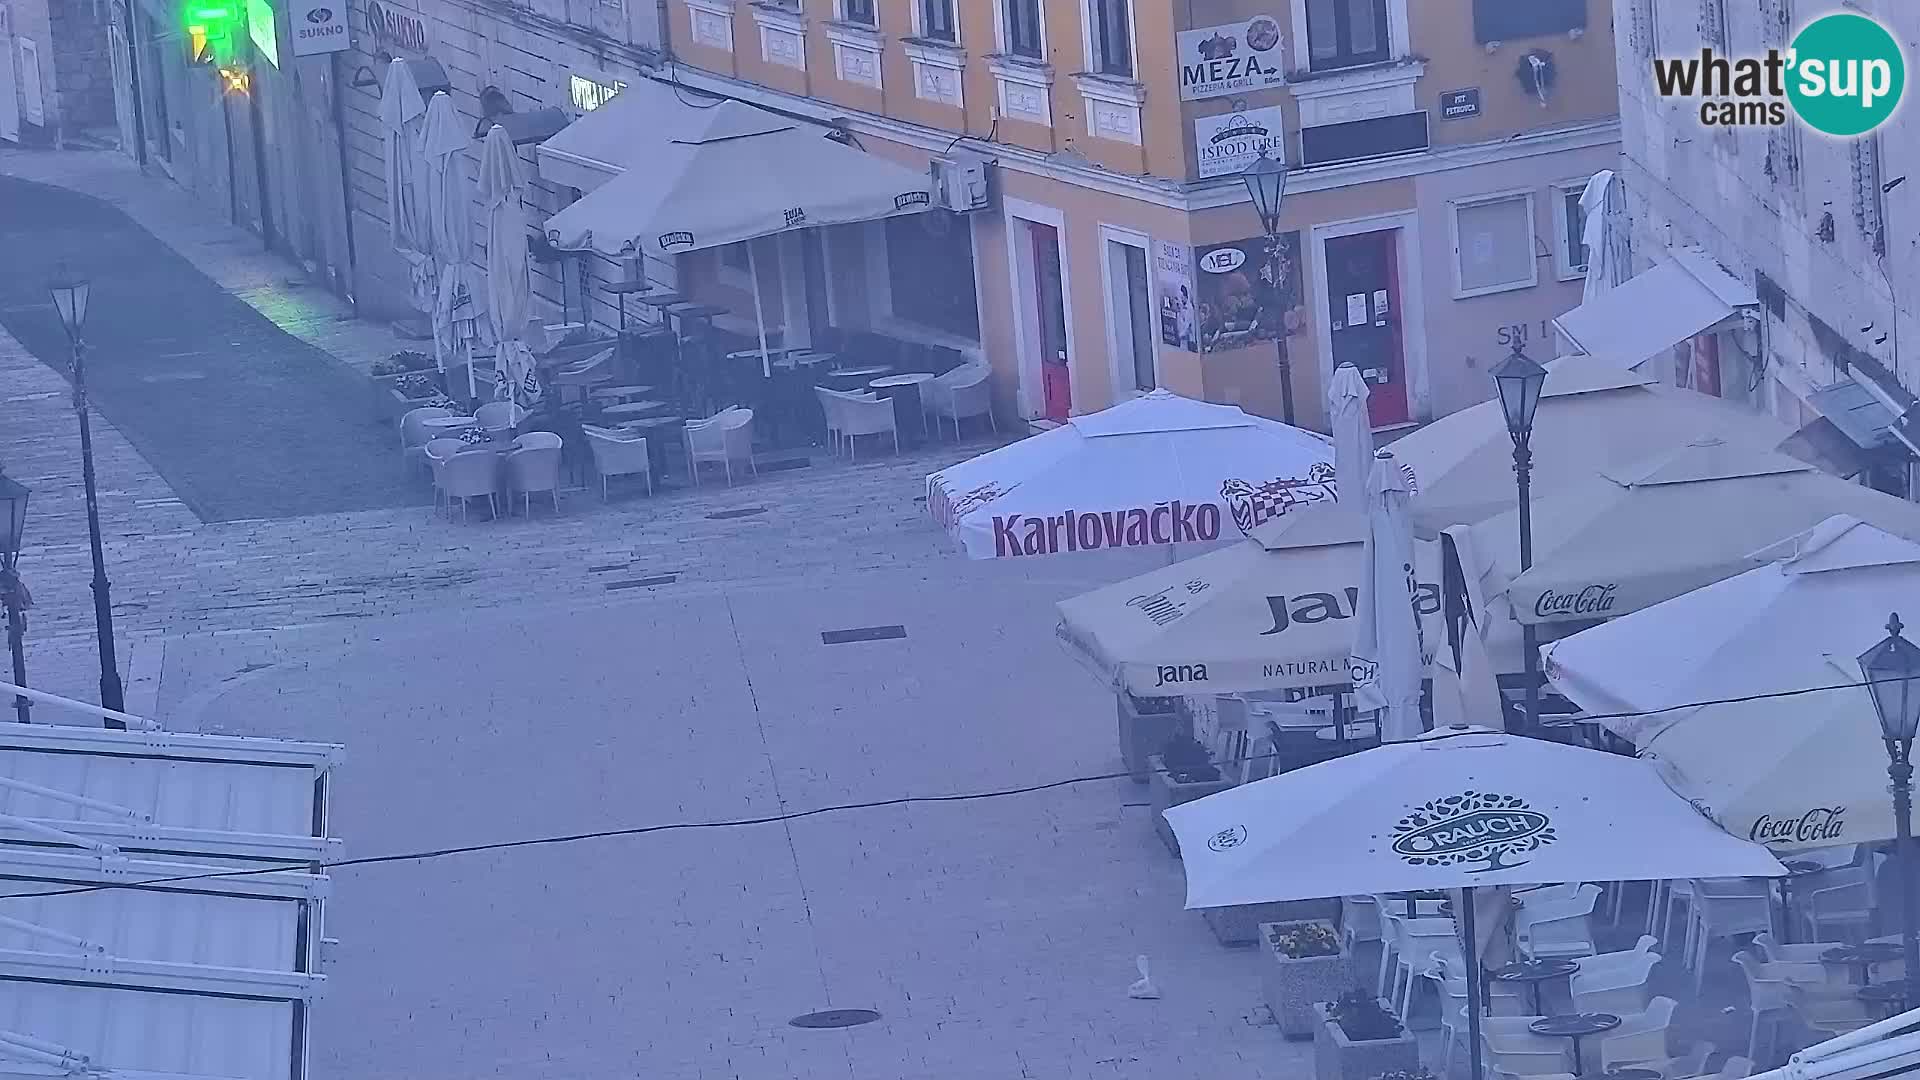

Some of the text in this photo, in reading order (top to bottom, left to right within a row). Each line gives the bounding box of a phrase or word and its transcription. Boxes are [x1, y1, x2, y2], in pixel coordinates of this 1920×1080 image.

[299, 25, 343, 39] SUKNO
[386, 9, 424, 49] SUKNO
[1183, 56, 1262, 86] MEZA
[1193, 82, 1225, 94] PIZZERIA
[1233, 78, 1254, 88] GRILL
[1202, 142, 1247, 160] ISPOD
[1252, 136, 1281, 151] URE
[991, 500, 1221, 557] Karlovačko
[1263, 659, 1338, 677] NATURAL
[1433, 815, 1532, 847] RAUCH
